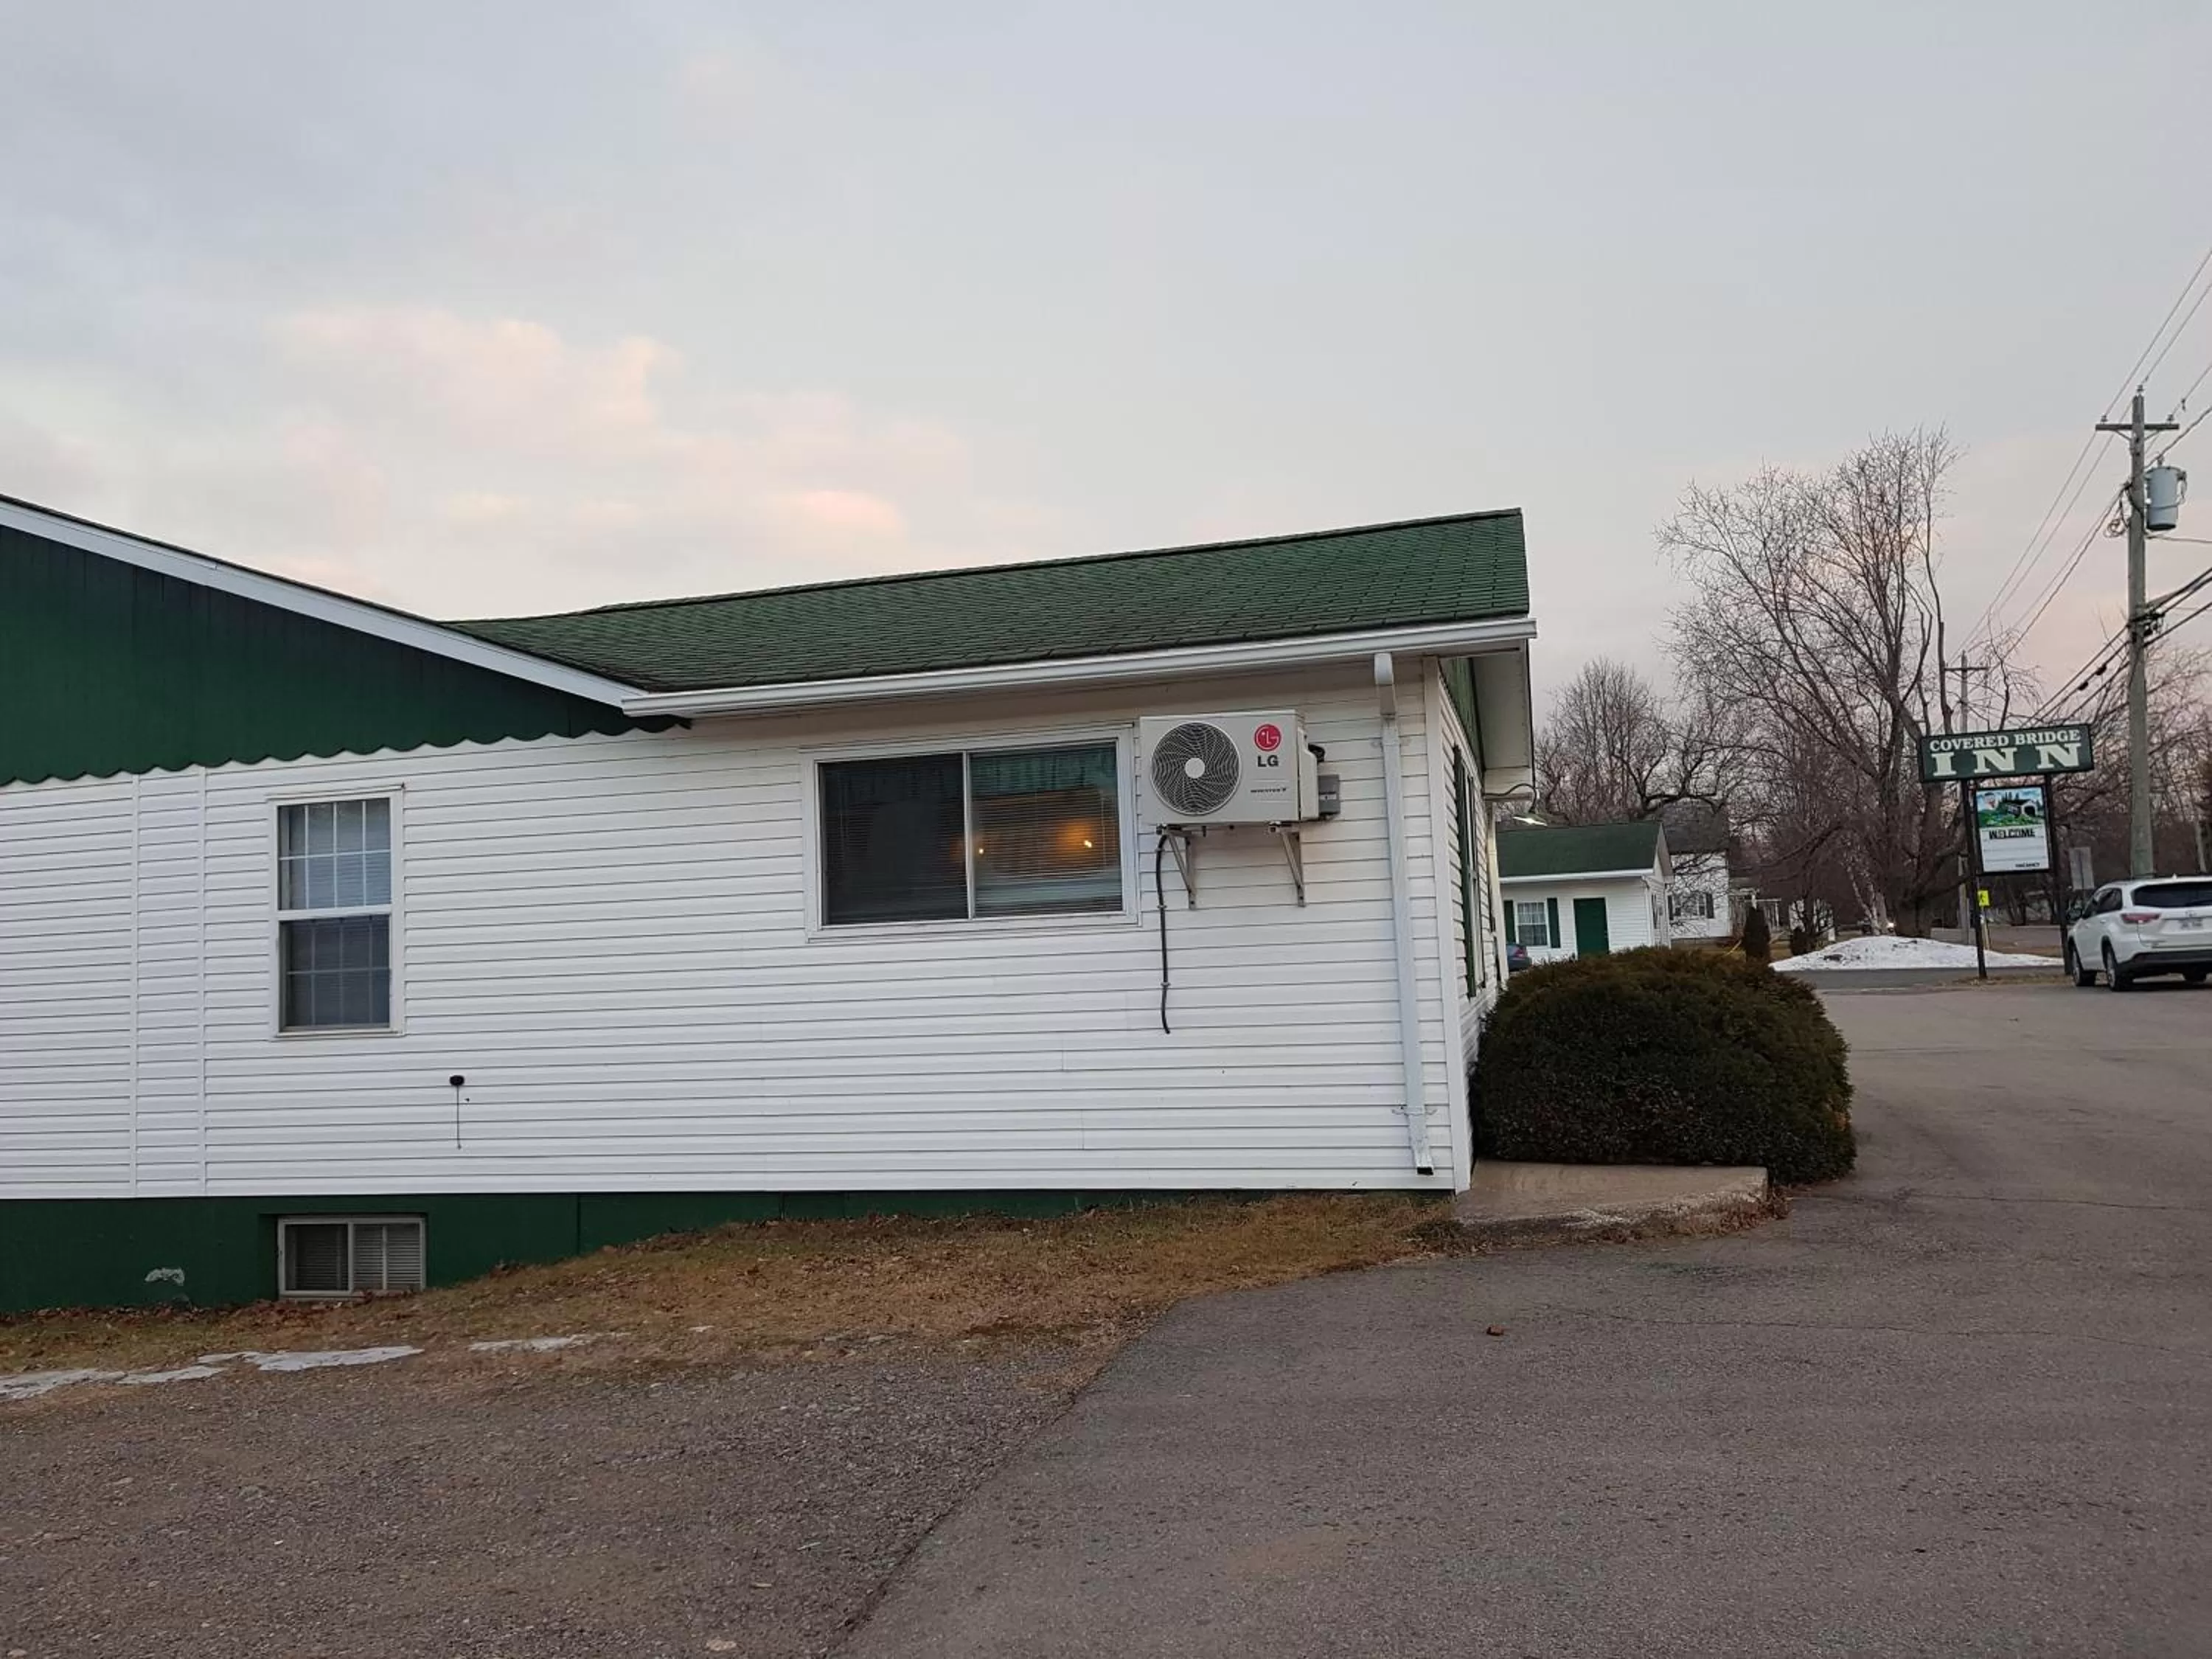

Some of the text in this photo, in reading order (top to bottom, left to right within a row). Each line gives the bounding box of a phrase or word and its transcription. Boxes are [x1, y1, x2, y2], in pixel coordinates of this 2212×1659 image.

[1930, 729, 2081, 751] COVERED BRIDGE
[1257, 754, 1279, 767] LG
[1931, 742, 2082, 776] INN
[1989, 828, 2036, 840] WELCOME
